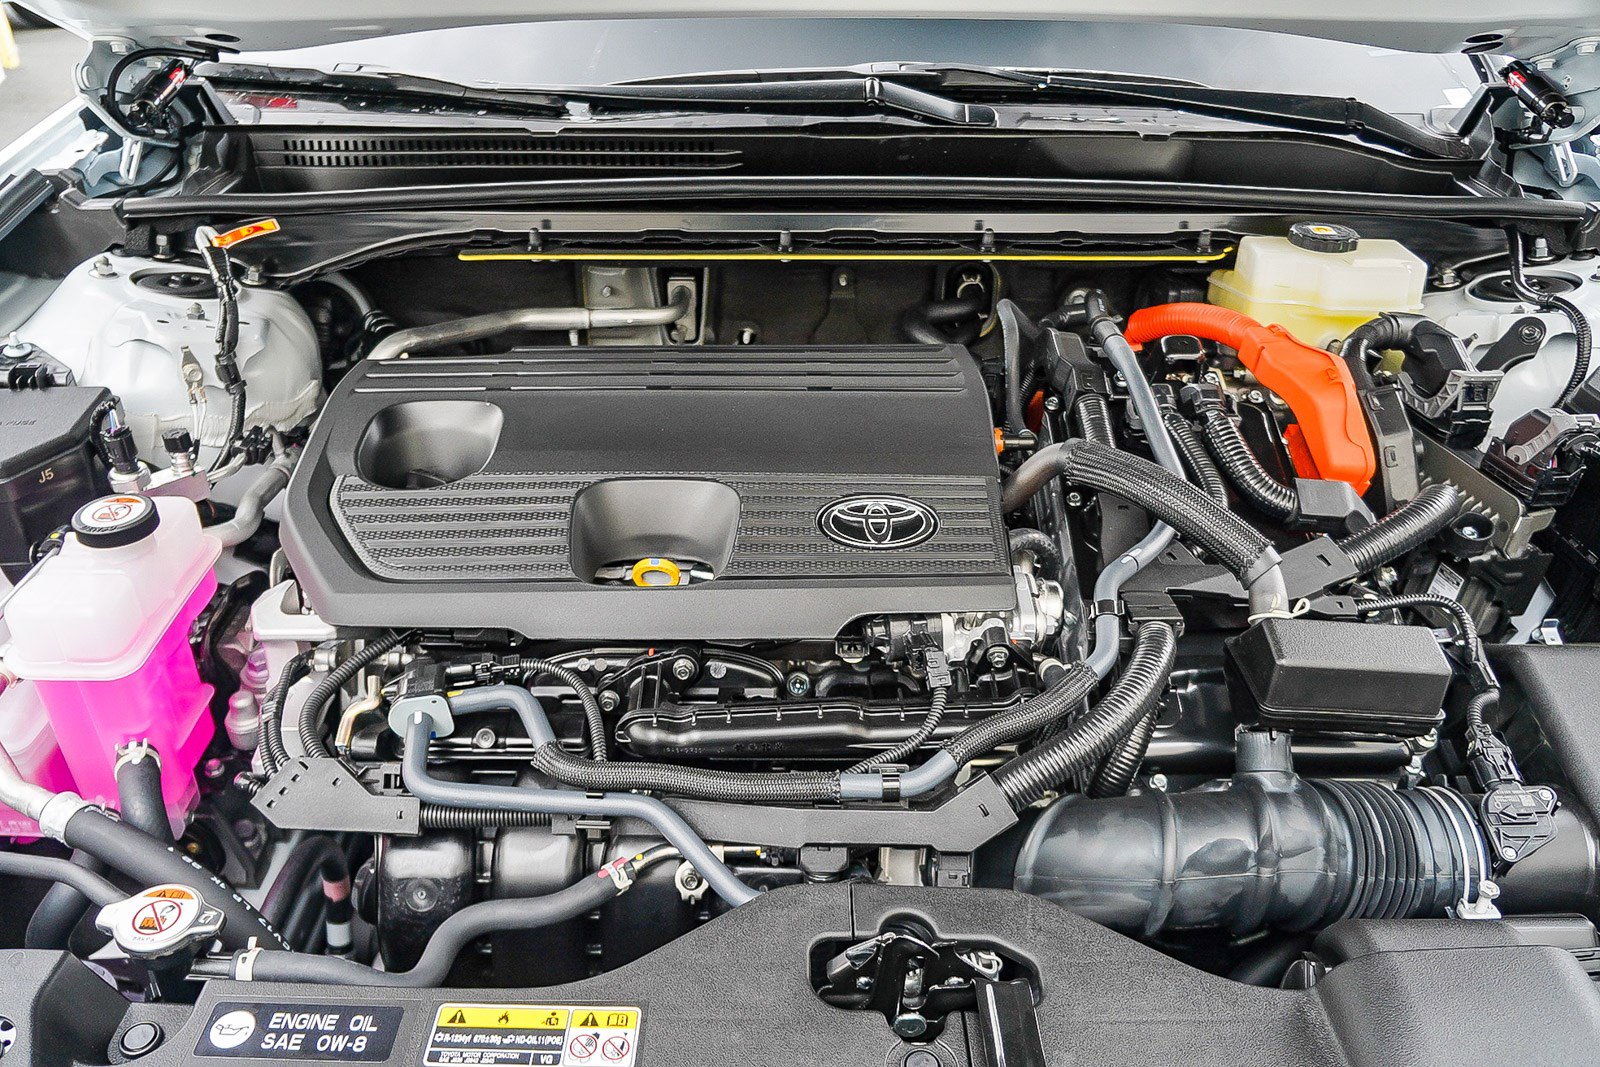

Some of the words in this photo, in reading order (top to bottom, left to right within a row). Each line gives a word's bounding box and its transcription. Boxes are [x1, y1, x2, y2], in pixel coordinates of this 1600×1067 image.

[39, 467, 54, 483] J5
[268, 1012, 339, 1031] ENGINE
[350, 1014, 378, 1032] OIL
[260, 1033, 305, 1050] SAE
[316, 1035, 368, 1052] 0W-8
